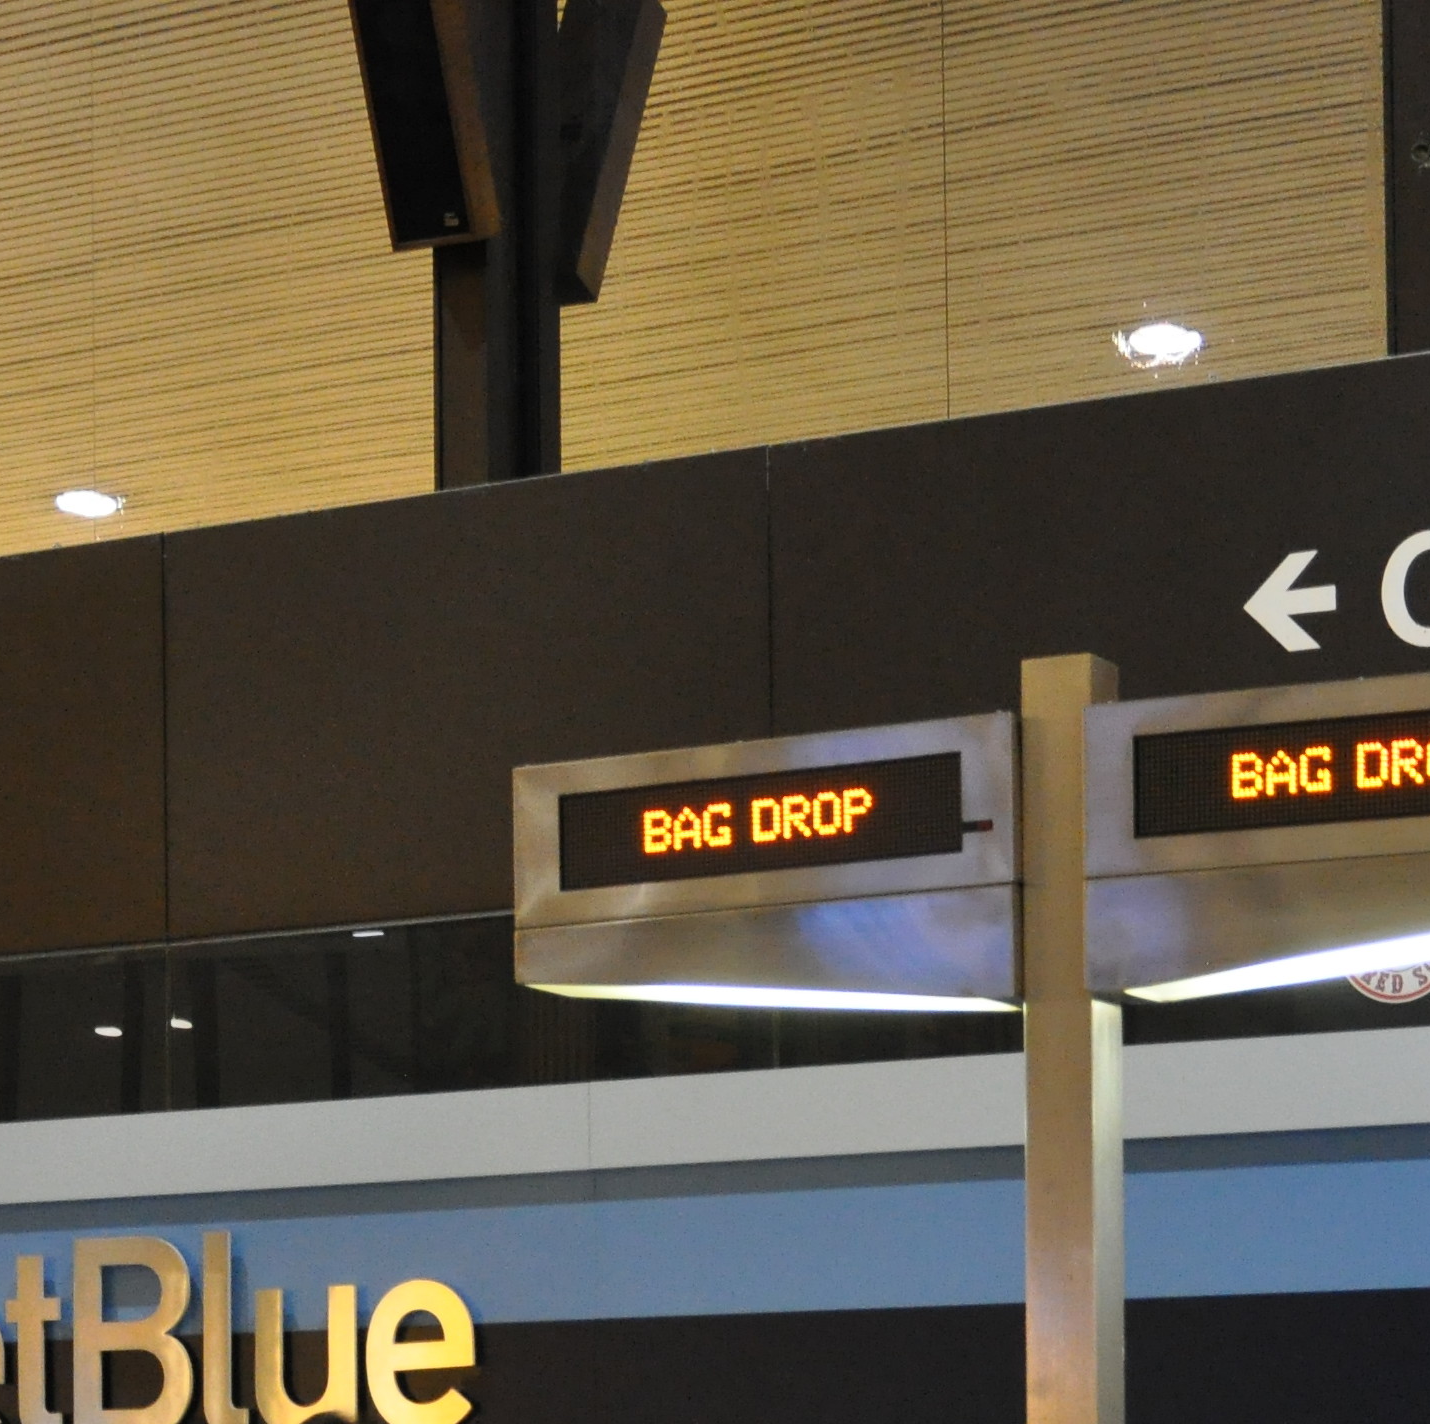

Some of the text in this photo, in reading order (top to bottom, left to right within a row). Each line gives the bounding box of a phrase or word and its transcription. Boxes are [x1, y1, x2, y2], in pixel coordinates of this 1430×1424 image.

[1230, 744, 1334, 800] BAG
[642, 787, 874, 855] BAG DROP
